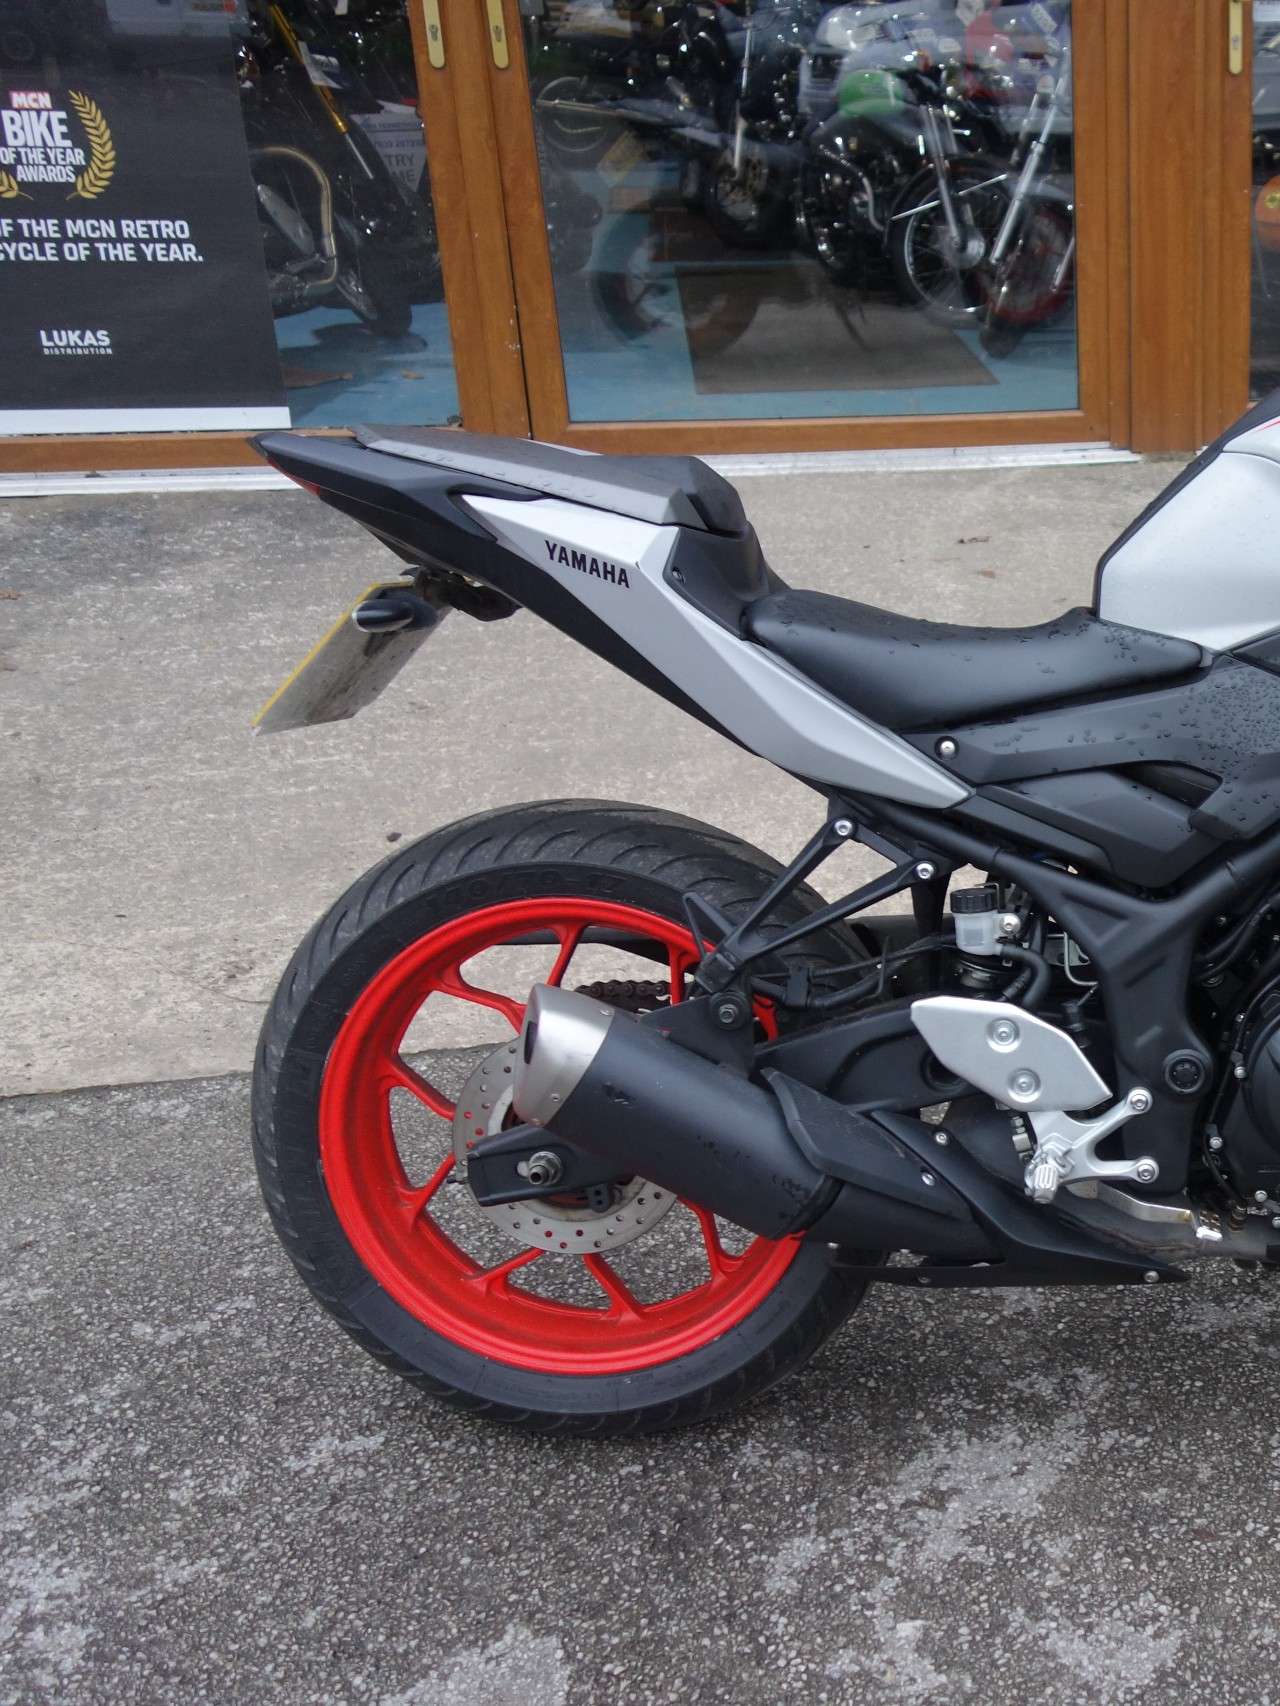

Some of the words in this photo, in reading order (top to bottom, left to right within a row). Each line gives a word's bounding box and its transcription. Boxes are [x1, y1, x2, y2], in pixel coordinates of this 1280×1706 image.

[10, 91, 53, 109] MCN
[1, 110, 73, 147] BIKE
[0, 147, 17, 165] OF
[18, 147, 47, 165] THE
[47, 148, 86, 166] YEAR
[16, 165, 77, 183] AWARDS
[0, 219, 14, 238] F
[17, 219, 62, 238] THE
[65, 219, 117, 239] MCN
[121, 220, 190, 239] RETRO
[63, 243, 91, 262] OF
[95, 243, 138, 262] THE
[141, 243, 204, 262] YEAR.
[40, 330, 111, 347] LUKAS
[43, 347, 113, 355] DISTRIBUTION
[544, 539, 630, 589] YAMAHA
